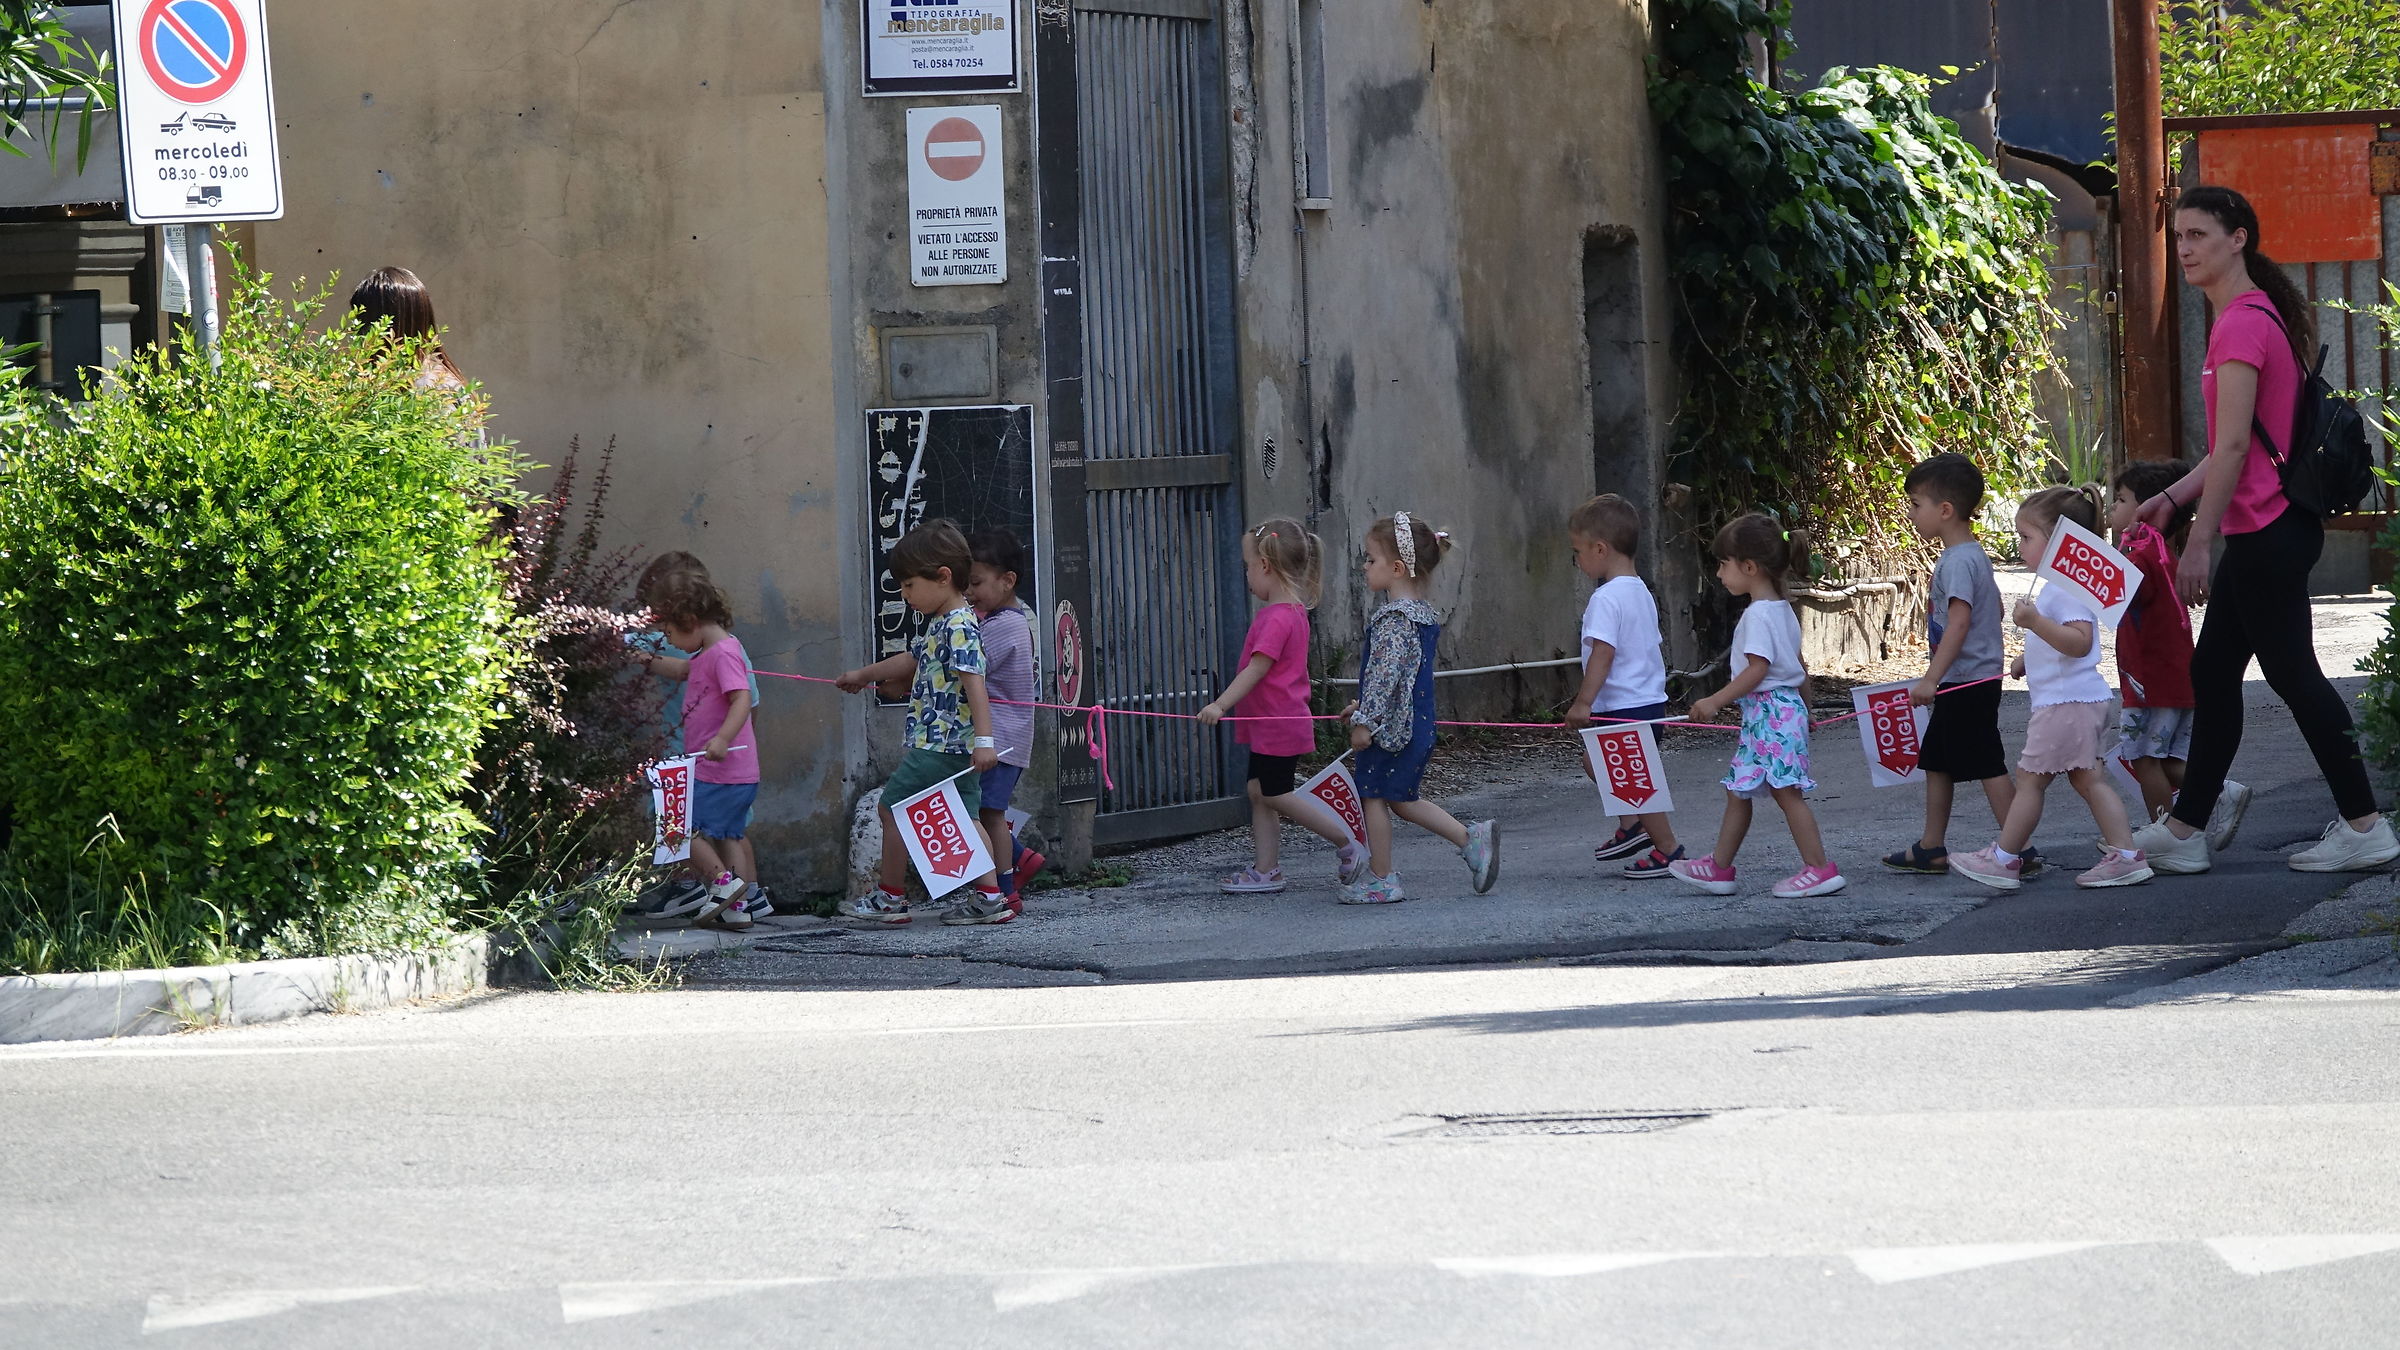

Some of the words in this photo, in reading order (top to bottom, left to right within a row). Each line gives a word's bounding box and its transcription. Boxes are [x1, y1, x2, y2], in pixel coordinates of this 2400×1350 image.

[887, 13, 1005, 35] mencaraglia
[911, 9, 981, 18] TIPOGRAFIA
[911, 37, 969, 46] www.mencaraglia.it
[911, 45, 975, 53] posta@mencaraglia.it
[912, 60, 929, 69] Tel.
[930, 59, 953, 68] 0584
[955, 58, 984, 68] 70254
[155, 141, 247, 160] mercoledì
[916, 206, 961, 220] PROPRIETÀ
[964, 206, 998, 218] PRIVATA
[917, 233, 951, 244] VIETATO
[955, 231, 999, 243] L'ACCESSO
[928, 249, 948, 260] ALLE
[952, 248, 989, 259] PERSONE
[921, 266, 939, 277] NON
[943, 263, 998, 275] AUTORIZZATE
[2069, 542, 2115, 580] 1000
[2056, 557, 2110, 601] MIGLIA
[1874, 701, 1896, 756] 1000
[1892, 693, 1917, 756] MIGLIA
[1604, 739, 1629, 788] 1000
[1622, 734, 1650, 790] MIGLIA
[1321, 789, 1359, 831] 1000
[914, 810, 946, 862] 1000
[929, 796, 967, 856] MIGLIA
